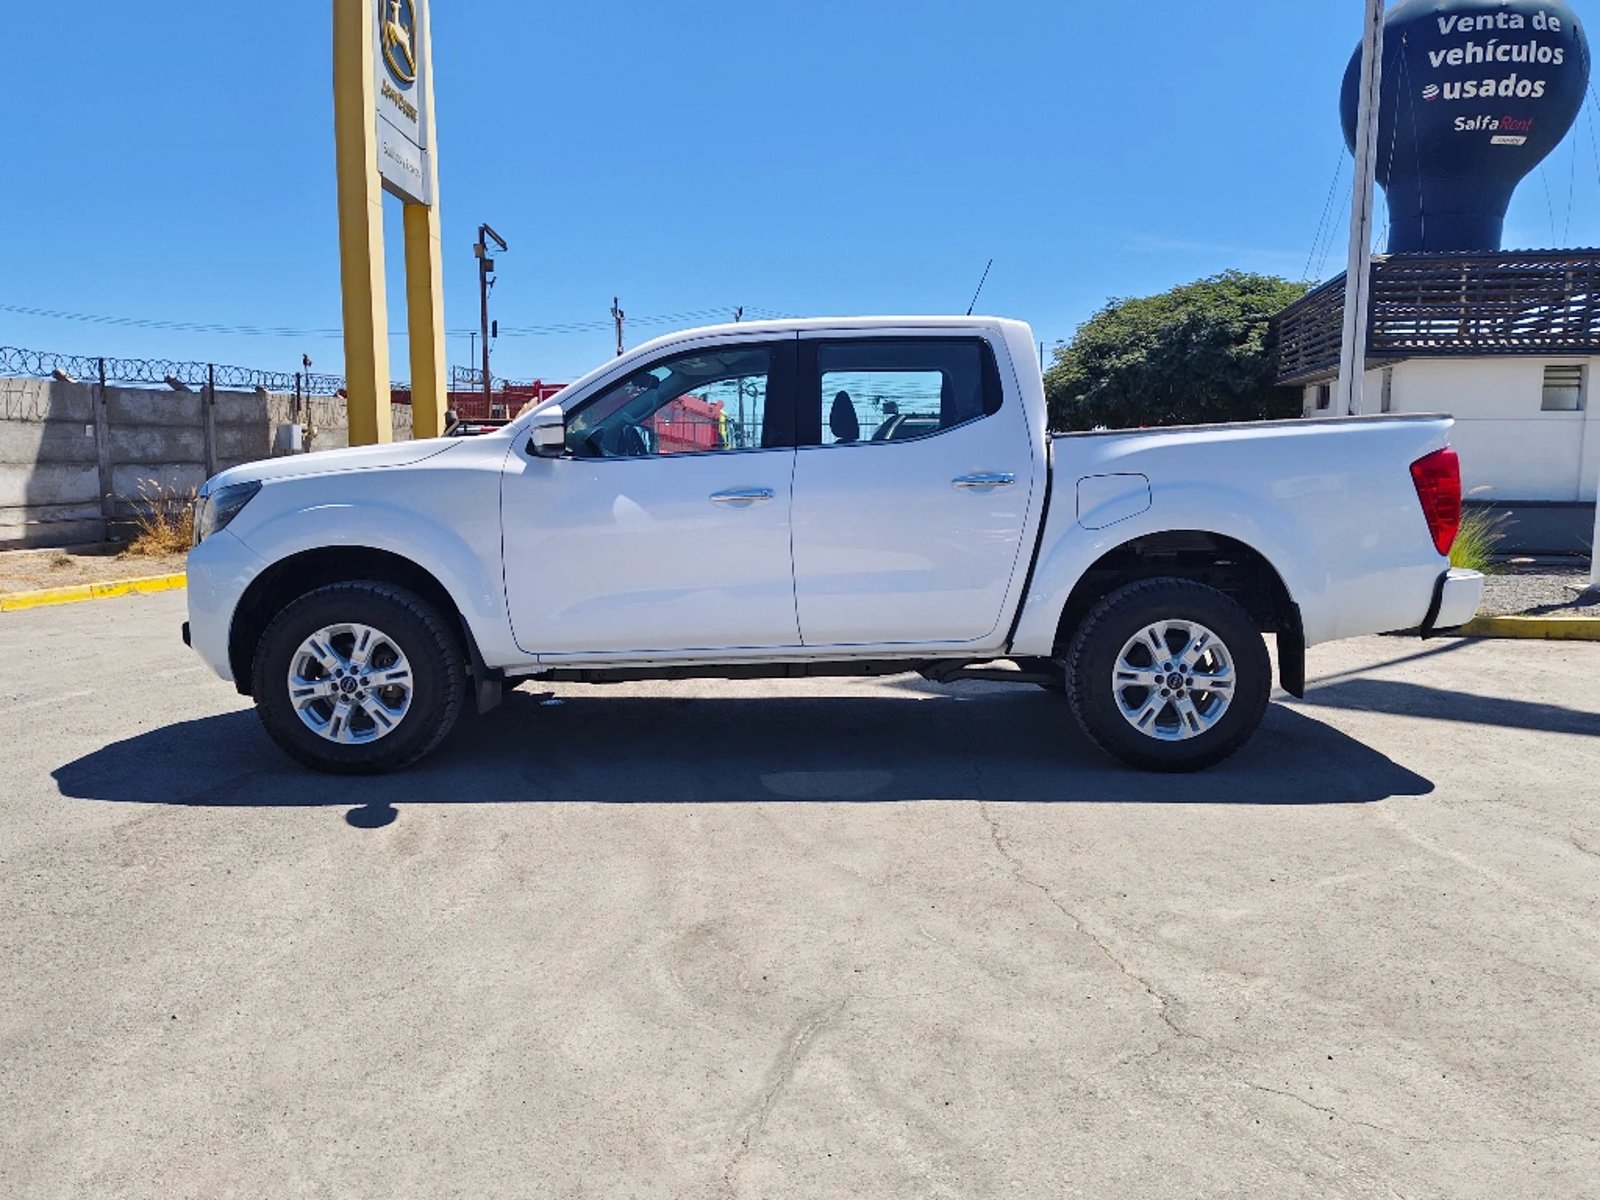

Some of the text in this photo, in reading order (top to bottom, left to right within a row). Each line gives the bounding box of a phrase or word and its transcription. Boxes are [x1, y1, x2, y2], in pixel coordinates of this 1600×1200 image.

[1437, 11, 1561, 35] Venta de
[1428, 39, 1565, 68] vehículos
[1443, 73, 1546, 100] usados
